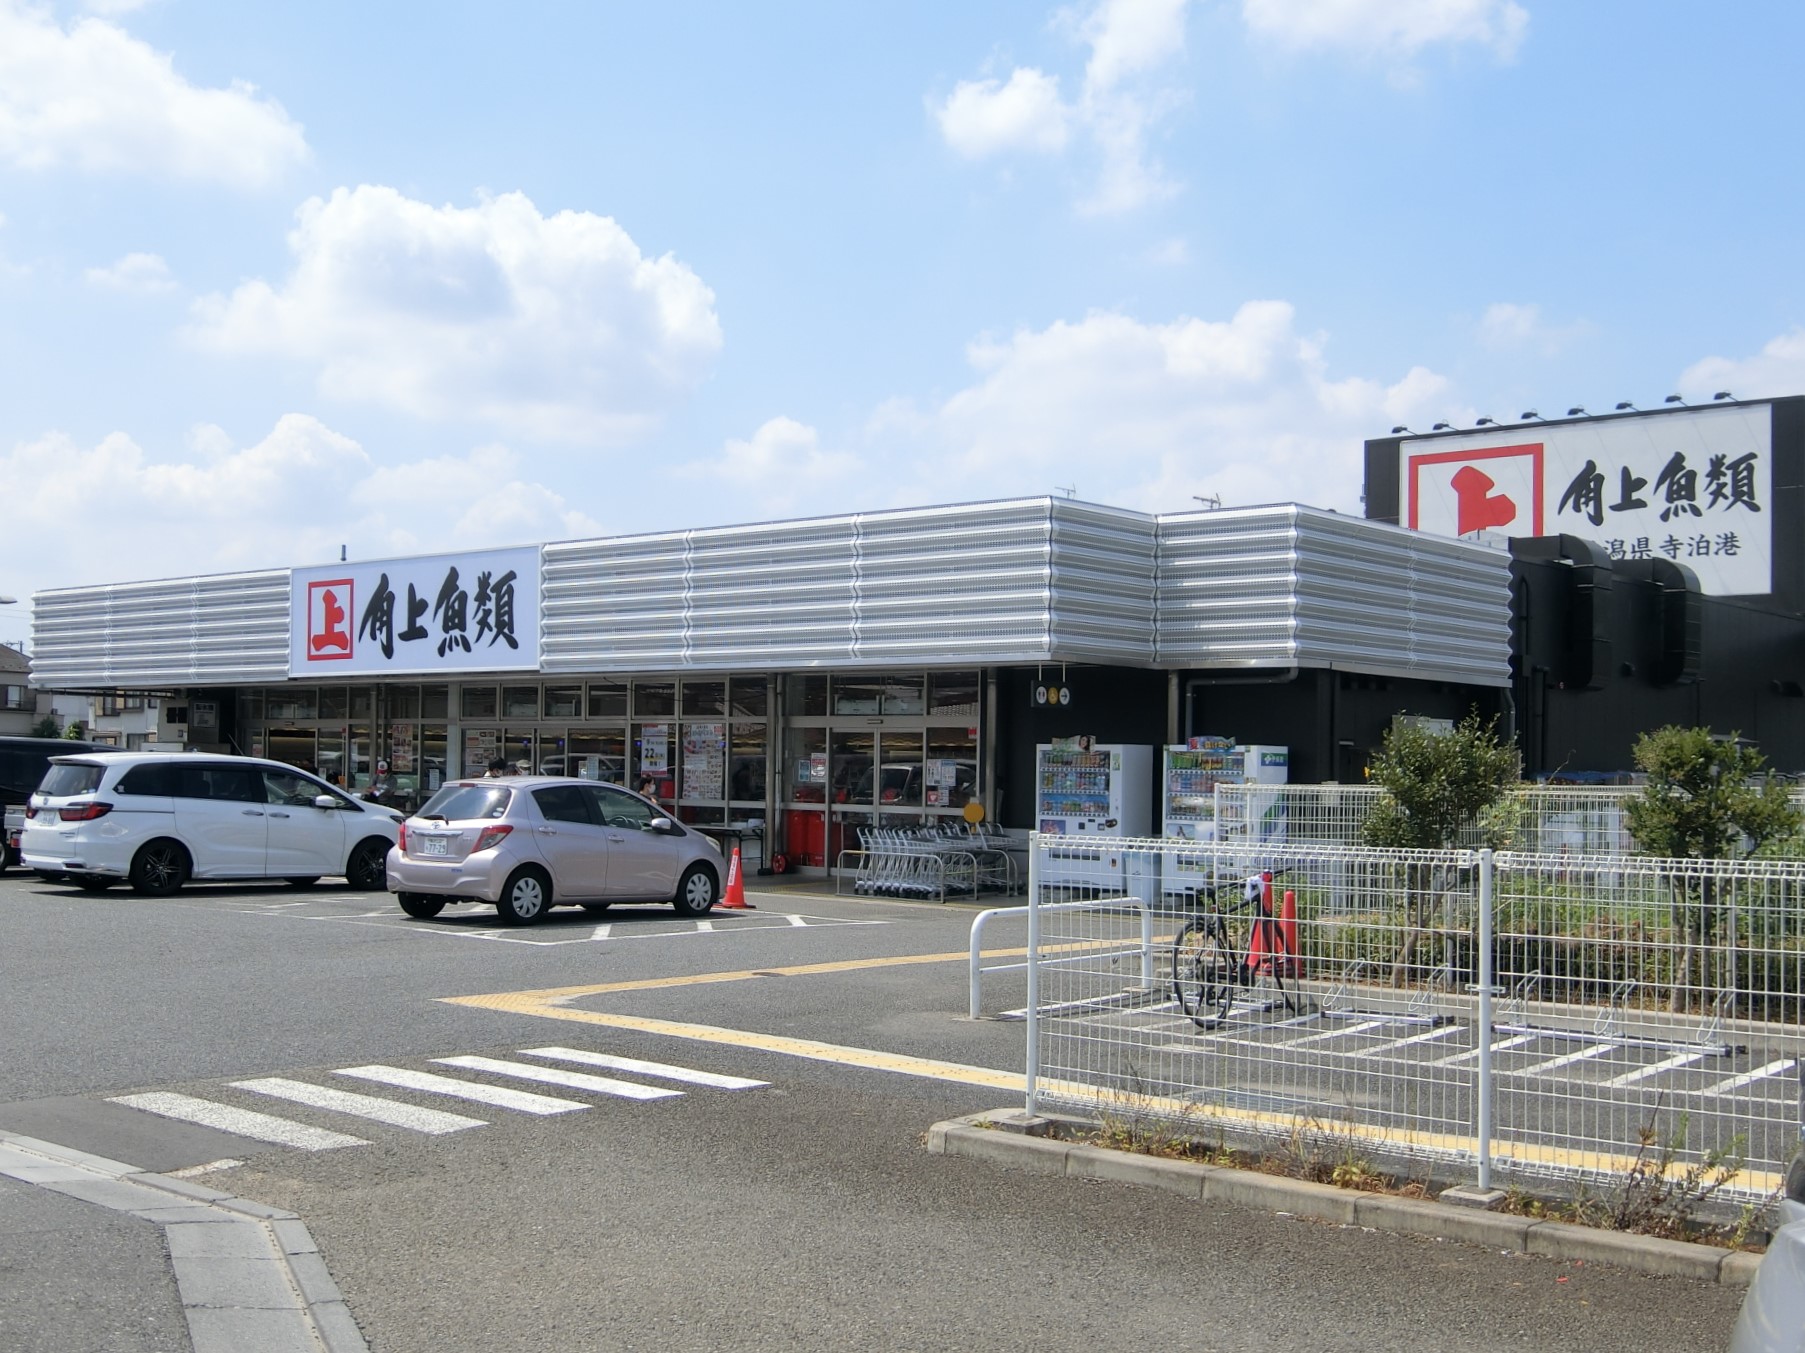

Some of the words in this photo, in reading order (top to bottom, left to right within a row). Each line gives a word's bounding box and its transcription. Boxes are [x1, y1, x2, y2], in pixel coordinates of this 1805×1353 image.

[1558, 451, 1762, 527] 角上魚類
[1603, 531, 1741, 560] 潟県寺泊港
[312, 589, 349, 651] 上
[359, 566, 518, 660] 角上魚類
